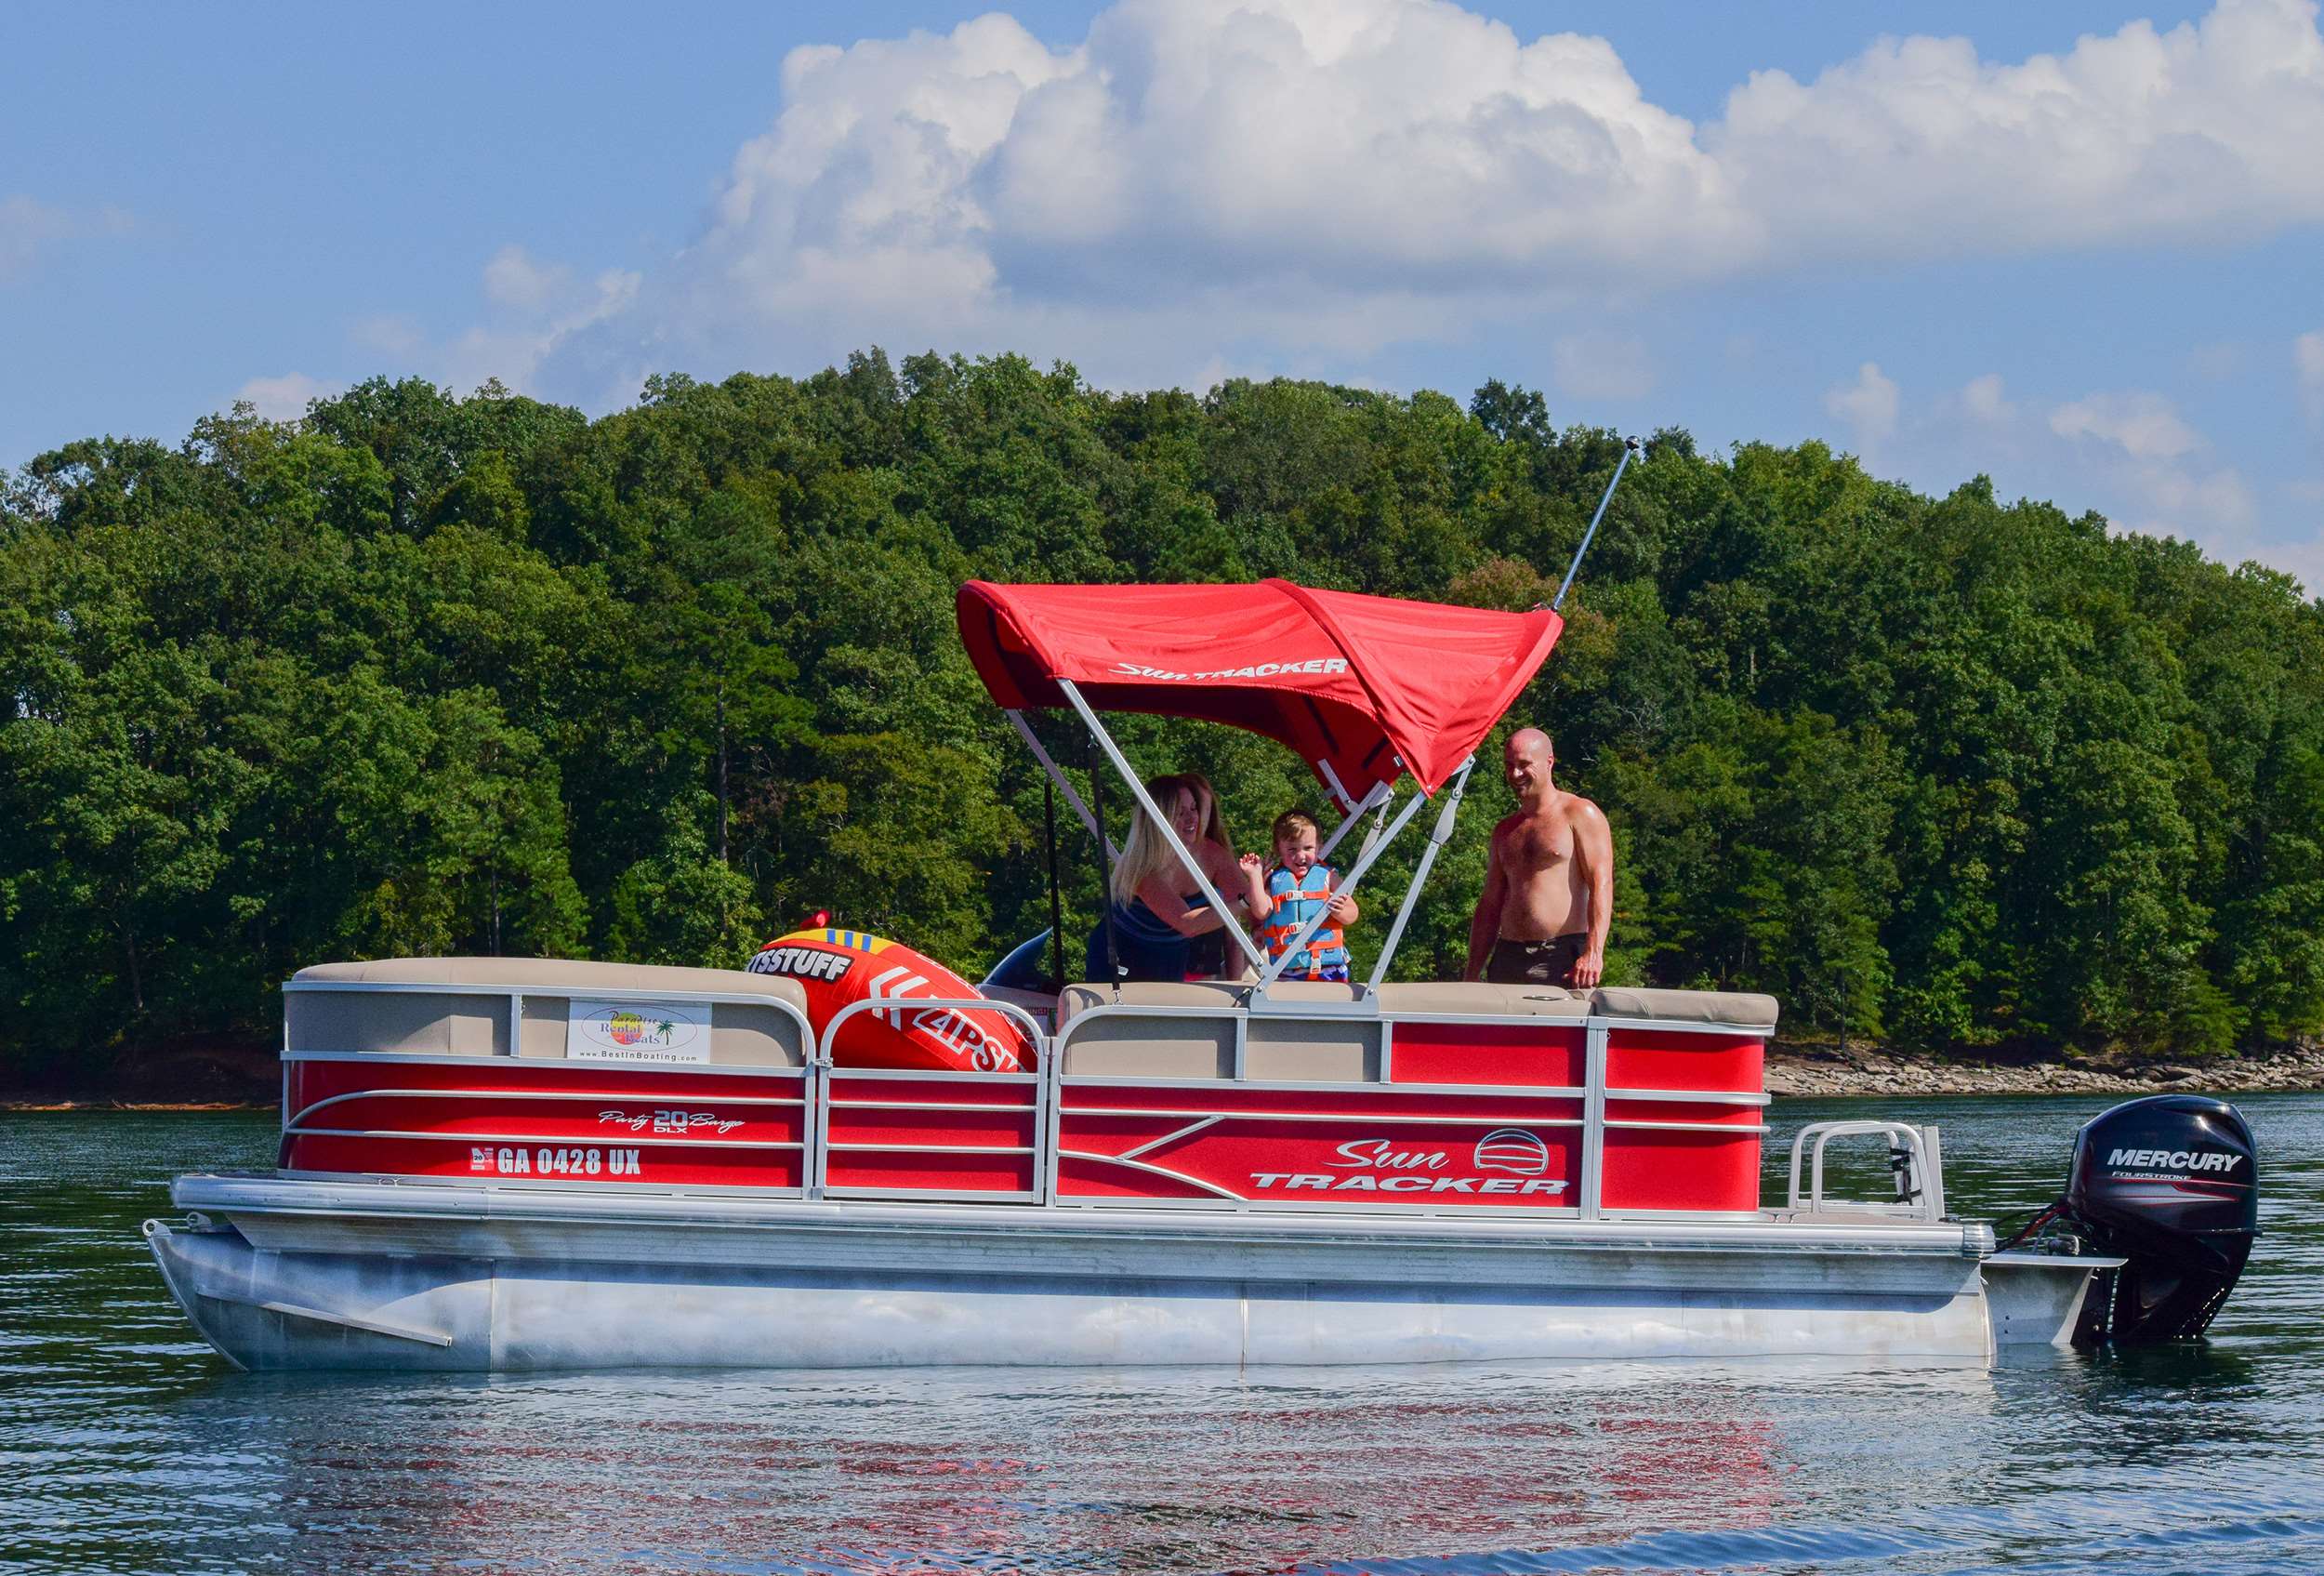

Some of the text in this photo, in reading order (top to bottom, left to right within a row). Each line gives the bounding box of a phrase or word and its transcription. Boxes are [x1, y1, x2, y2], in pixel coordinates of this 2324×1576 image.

[1108, 658, 1348, 680] Sun TRACKER
[744, 947, 852, 981] TSSTUFF
[601, 1023, 640, 1033] Rental
[625, 1034, 660, 1044] Boats
[579, 1050, 697, 1063] www.BestInBoating.com
[598, 1109, 746, 1134] Party 20 Barge
[497, 1147, 640, 1175] GA 0428 UX
[1323, 1139, 1450, 1170] Sun
[2107, 1148, 2242, 1172] MERCURY
[1250, 1172, 1569, 1195] TRACKER
[2111, 1171, 2192, 1181] FOURSTROKE
